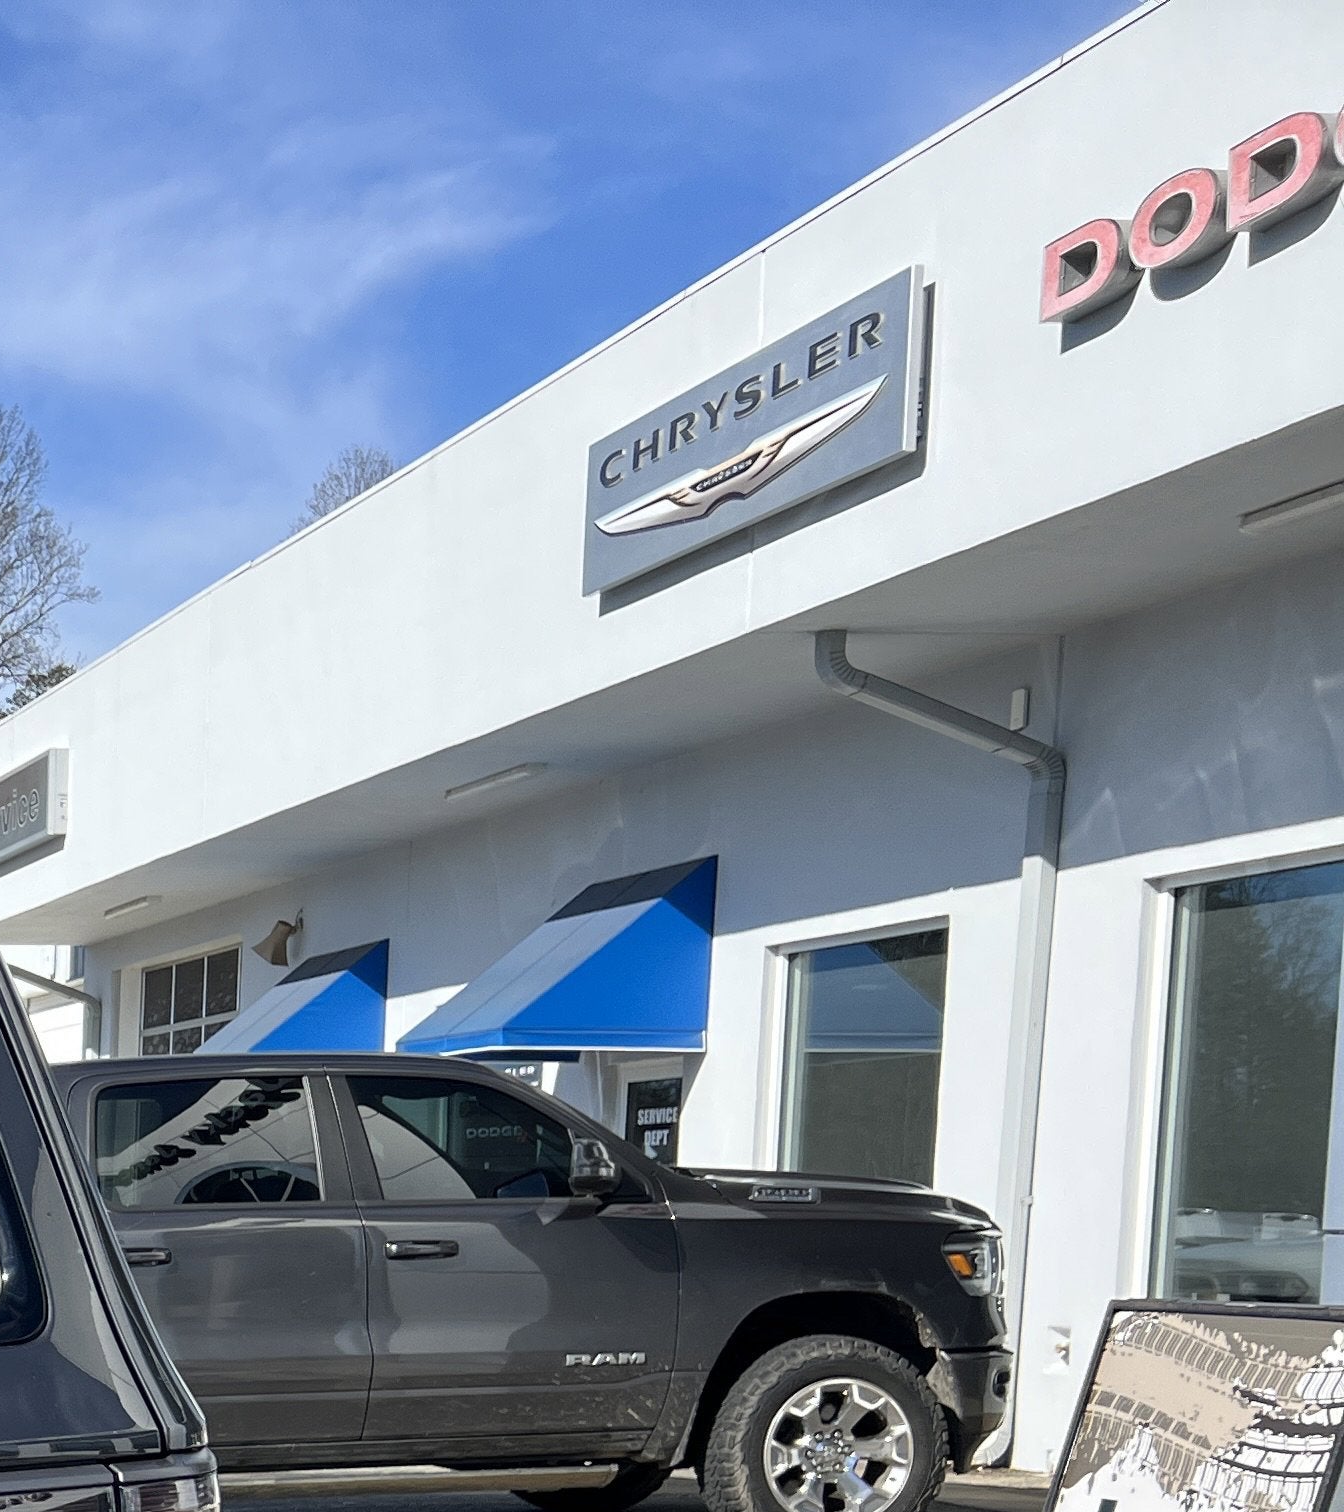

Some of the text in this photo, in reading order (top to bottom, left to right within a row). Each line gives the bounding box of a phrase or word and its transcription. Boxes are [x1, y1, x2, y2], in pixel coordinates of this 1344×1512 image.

[1040, 102, 1344, 324] DOD
[599, 311, 885, 489] CHRYSLER
[637, 1106, 678, 1126] SERVICE
[644, 1129, 669, 1146] DEPT
[565, 1352, 646, 1367] RAM
